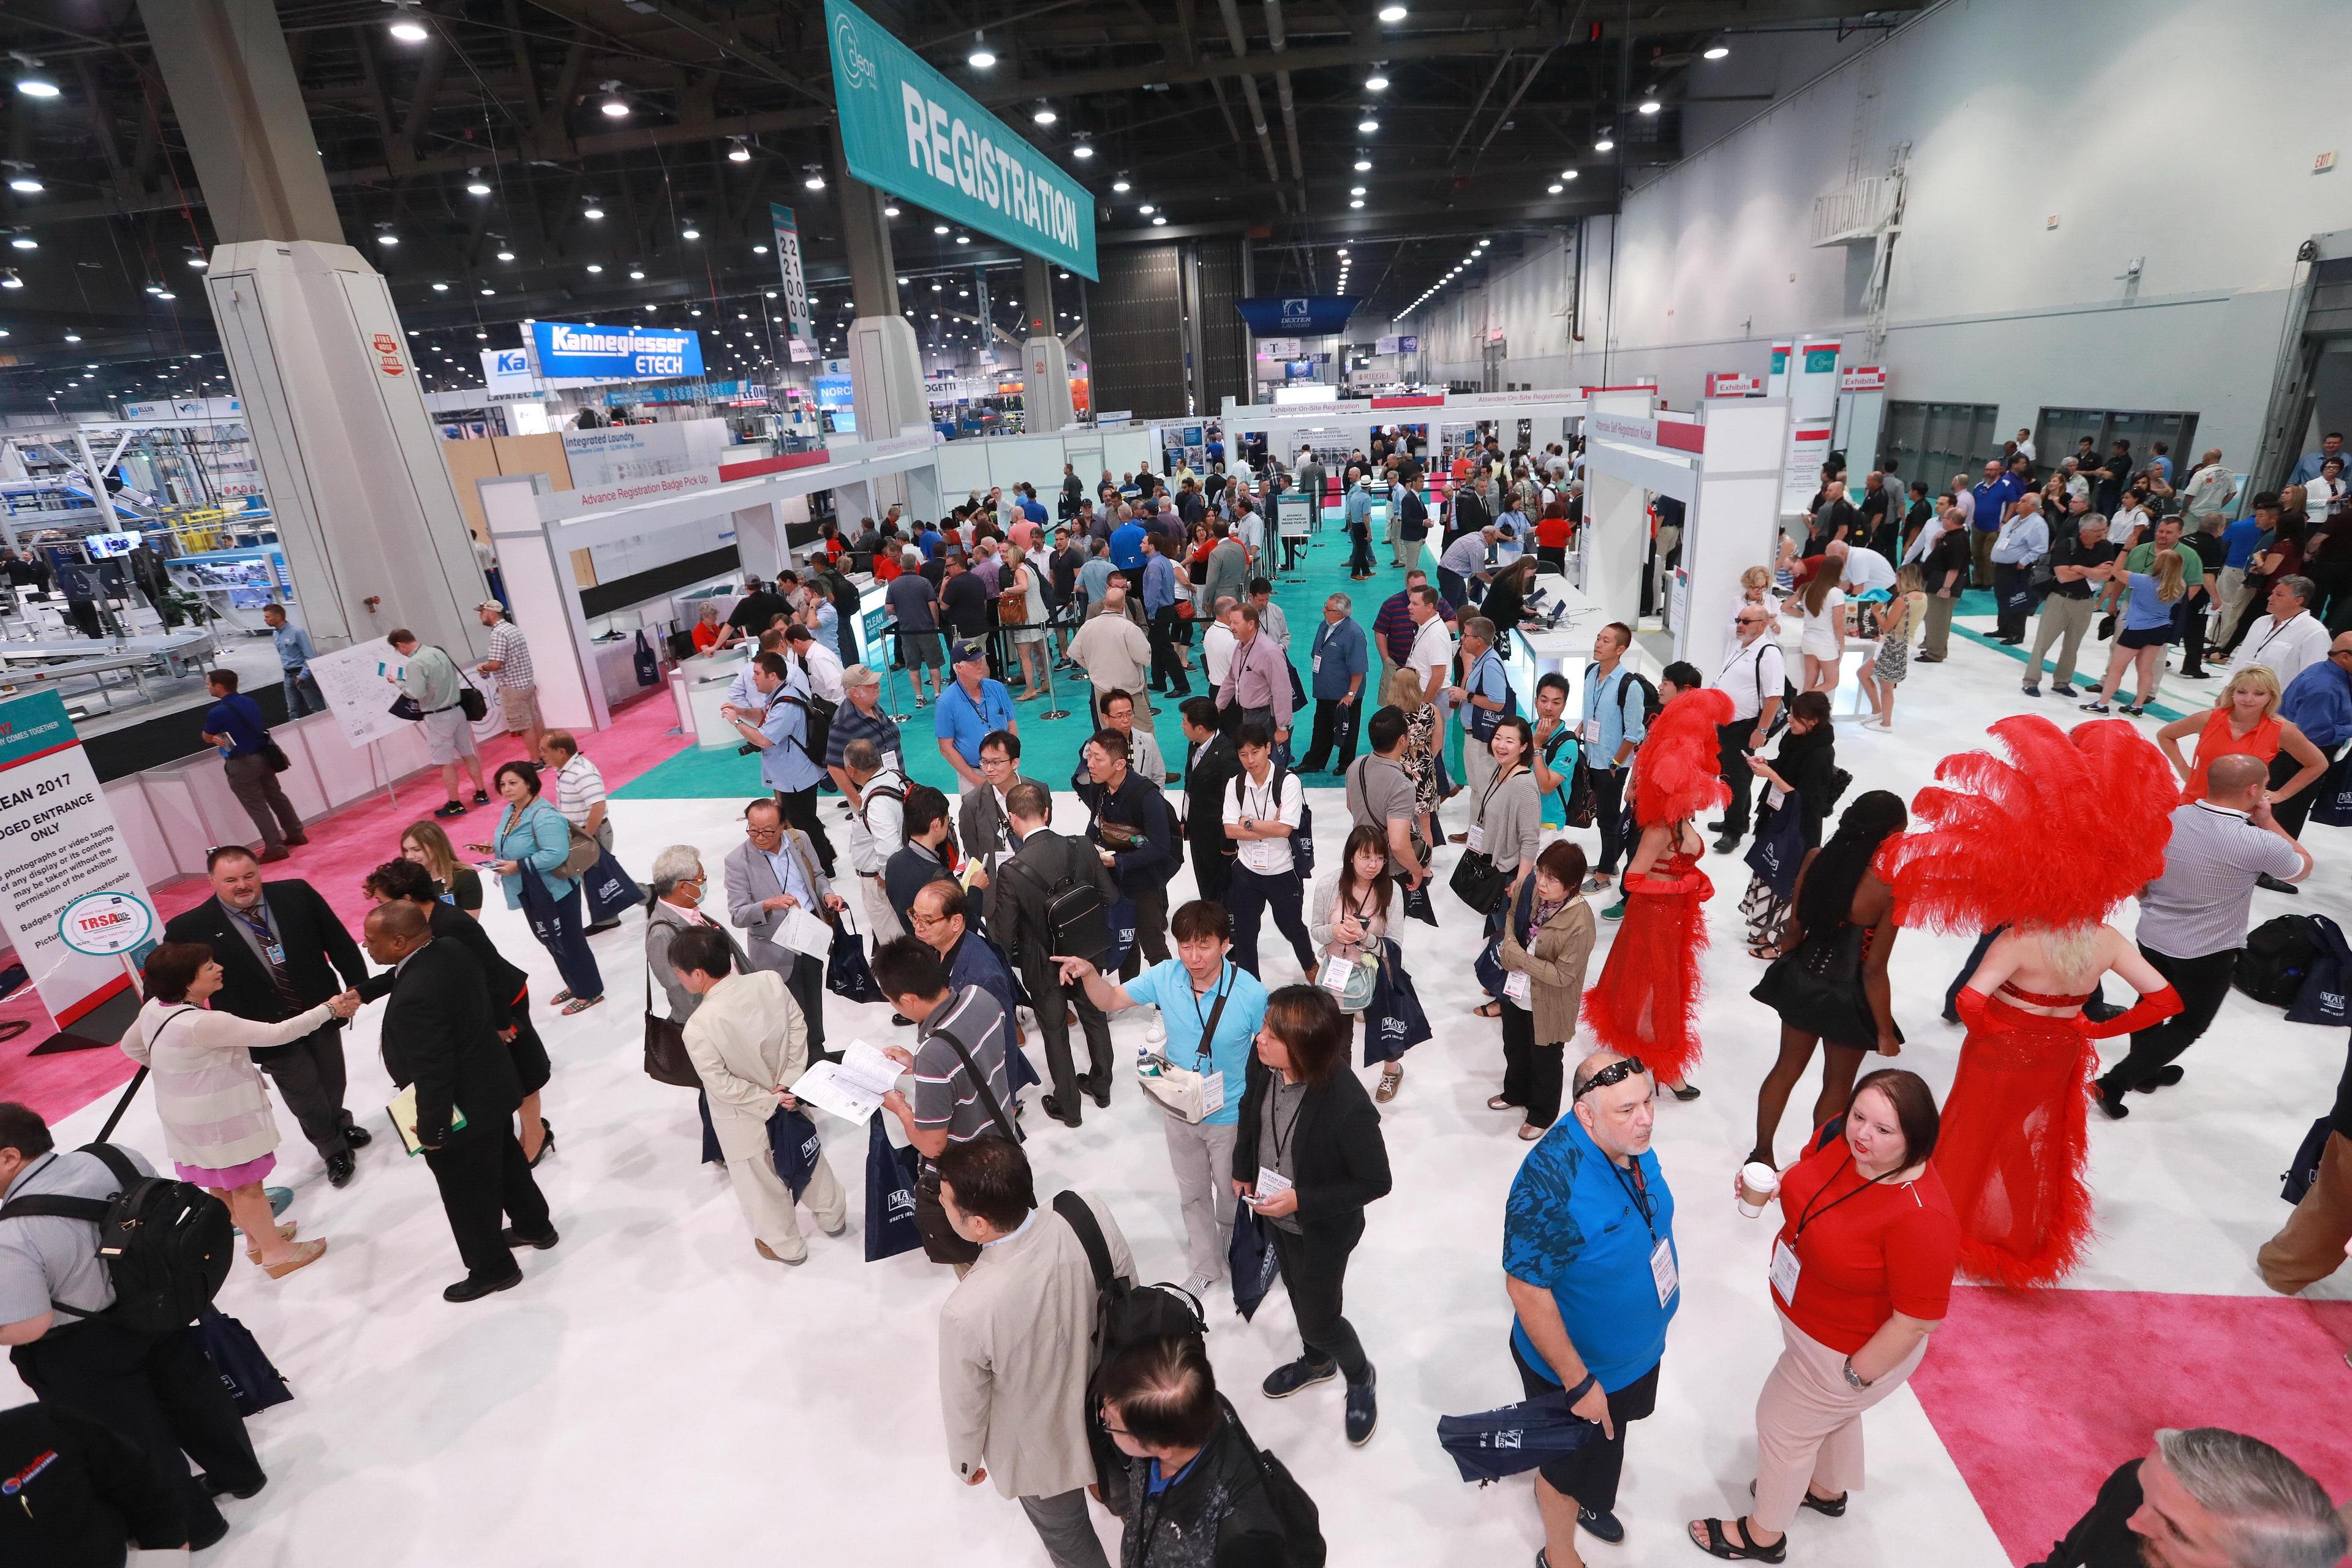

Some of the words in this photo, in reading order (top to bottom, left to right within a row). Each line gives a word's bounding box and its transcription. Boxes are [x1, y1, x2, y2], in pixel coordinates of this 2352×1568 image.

[902, 80, 1079, 252] REGISTRATION
[2315, 153, 2331, 168] EXIT
[552, 326, 687, 357] Kannegiesser
[635, 355, 683, 374] ETECH
[1363, 371, 1390, 380] RIEGEL
[821, 386, 853, 398] NORC
[1533, 392, 1571, 401] Registration
[1323, 402, 1360, 411] Registration
[566, 435, 606, 448] Integrated
[608, 431, 635, 443] Laundry
[582, 492, 616, 505] Advance
[618, 483, 661, 500] Registration
[662, 479, 683, 492] Badge
[684, 476, 697, 486] Pick
[699, 474, 708, 484] Up
[865, 613, 883, 630] CLEAN
[7, 733, 29, 744] COMES
[29, 721, 59, 736] TOGETHER
[36, 773, 71, 796] 2017
[33, 793, 95, 825] ENTRANCE
[31, 822, 60, 842] ONLY
[5, 850, 58, 880] photographs
[69, 836, 89, 849] video
[90, 824, 115, 839] taping
[1, 883, 10, 892] of
[12, 876, 28, 888] any
[29, 861, 58, 880] display
[81, 835, 115, 854] contents
[13, 888, 32, 899] may
[32, 881, 45, 889] be
[45, 869, 69, 883] taken
[70, 853, 99, 872] without
[100, 847, 113, 858] the
[15, 884, 61, 911] permission
[62, 878, 70, 887] of
[72, 872, 86, 883] the
[86, 855, 119, 875] exhibitor
[20, 912, 53, 932] Badges
[54, 905, 67, 914] are
[86, 872, 130, 894] transferable
[78, 913, 119, 931] TRSA
[1262, 1171, 1278, 1182] CLEAN
[889, 1214, 904, 1224] WHAT'S
